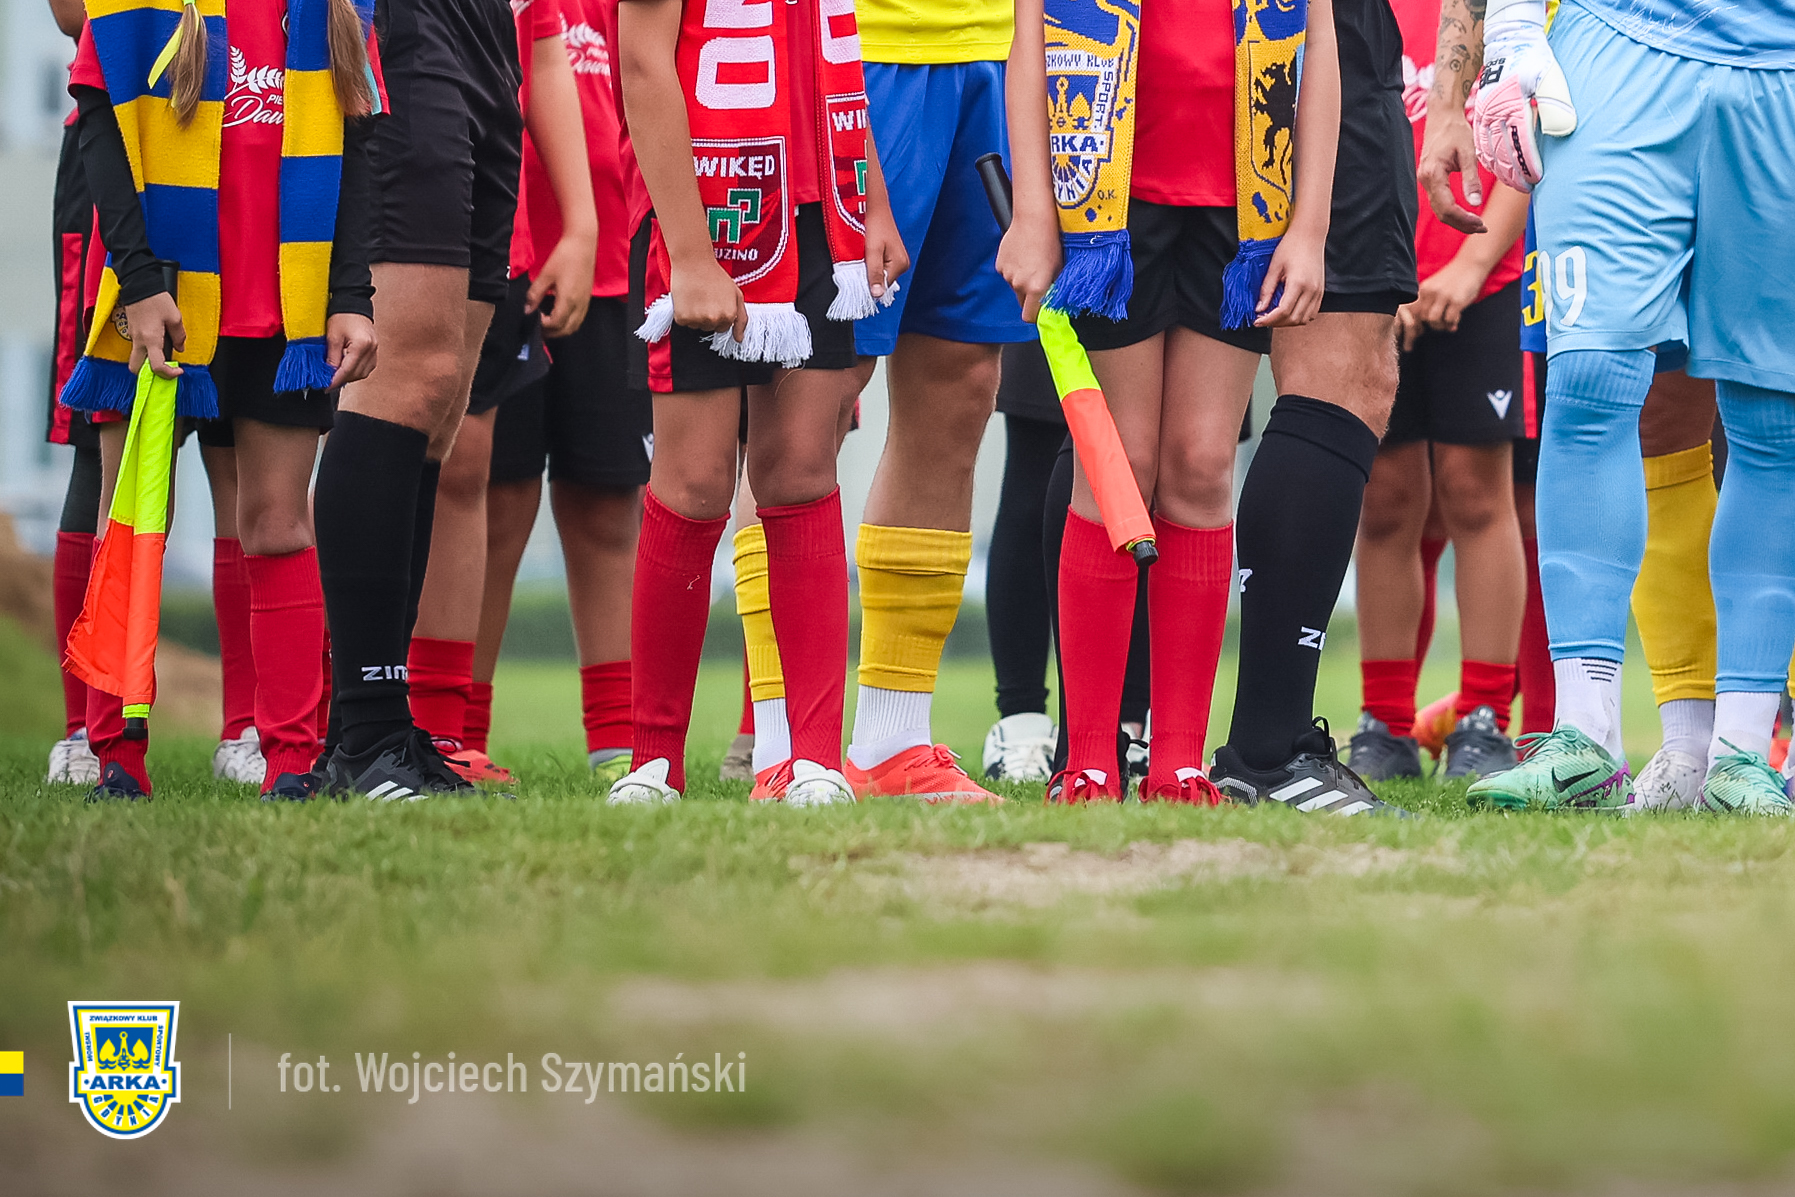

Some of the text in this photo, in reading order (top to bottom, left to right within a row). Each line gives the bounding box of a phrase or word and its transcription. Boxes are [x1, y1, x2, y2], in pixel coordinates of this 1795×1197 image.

[266, 93, 283, 105] PIE
[1051, 135, 1099, 153] RKA
[692, 154, 776, 180] WIKĘD
[713, 247, 759, 262] UZINO
